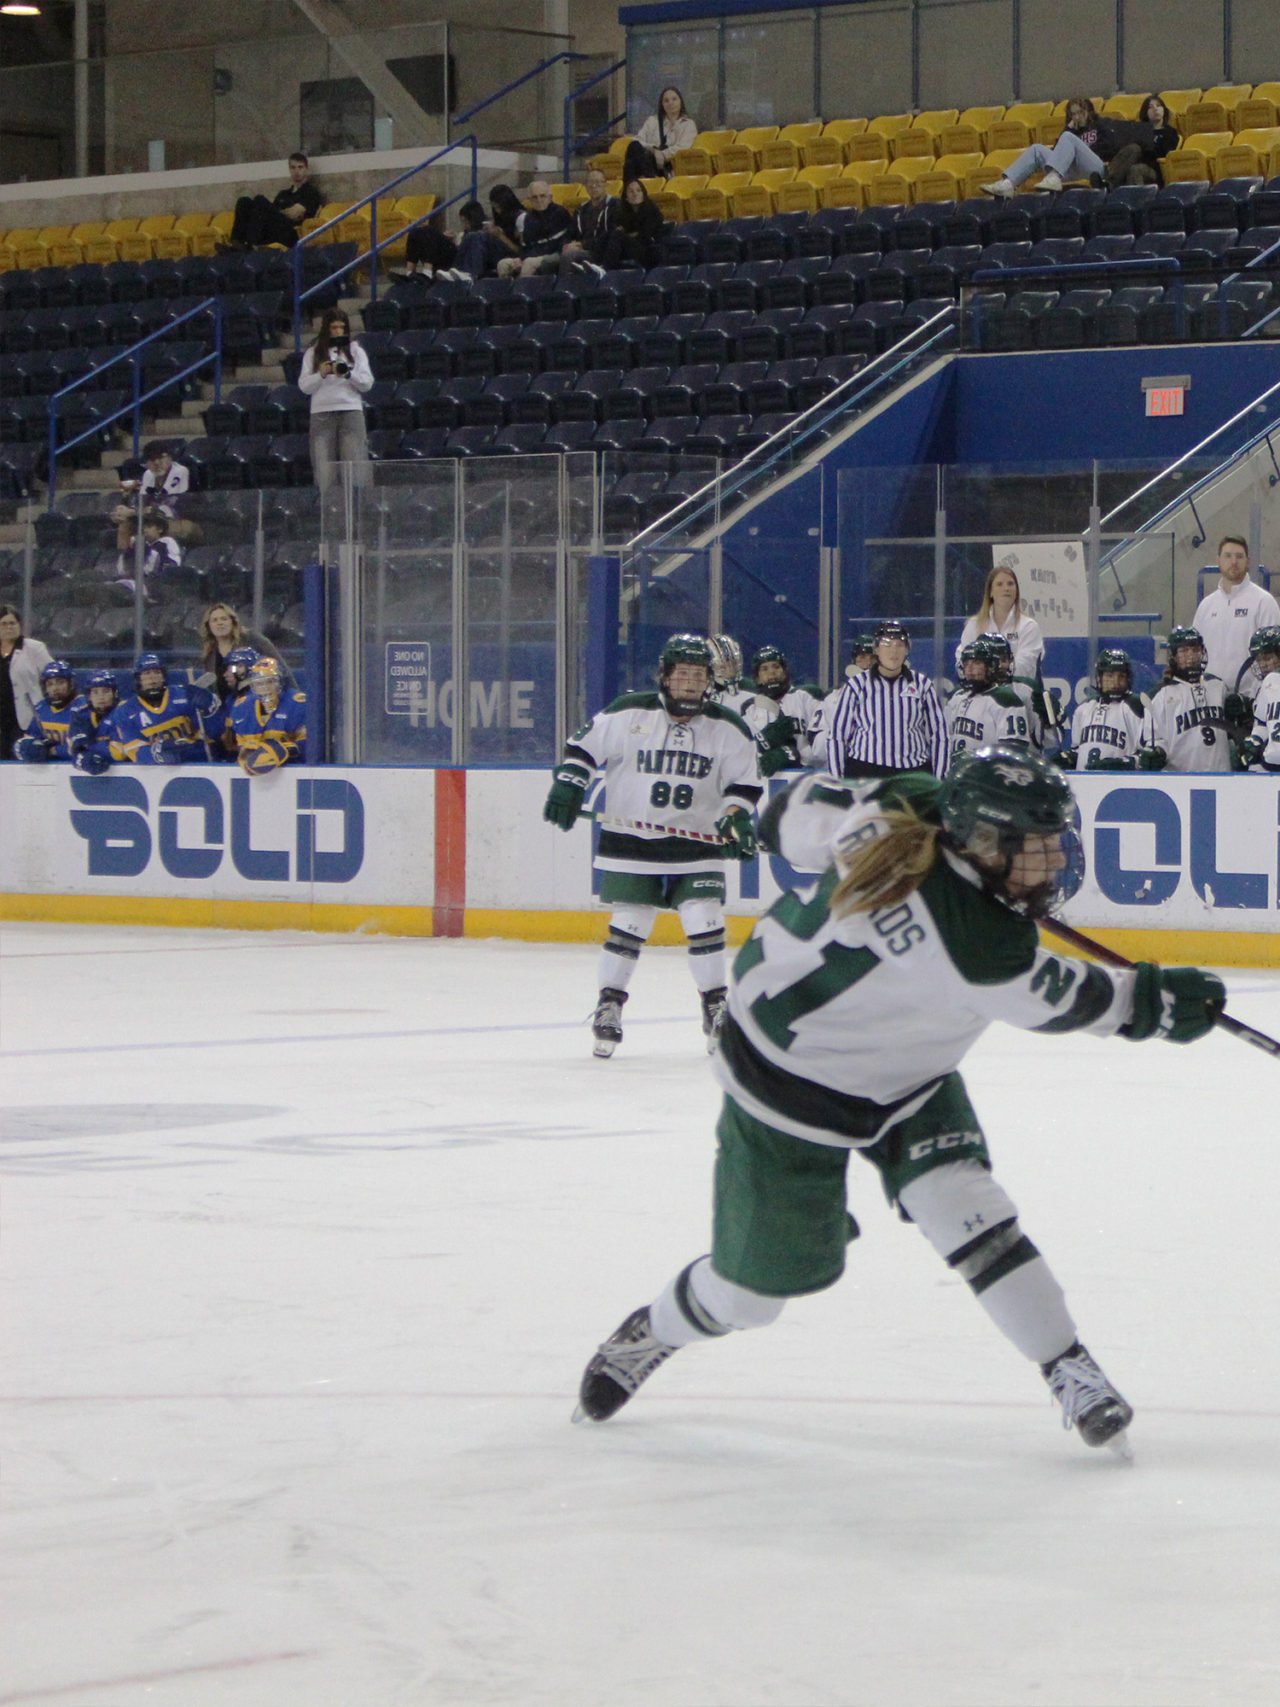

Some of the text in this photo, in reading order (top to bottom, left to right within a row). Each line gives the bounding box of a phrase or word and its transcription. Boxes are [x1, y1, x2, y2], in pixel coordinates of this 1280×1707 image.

[1151, 389, 1181, 415] EXIT
[410, 680, 535, 728] HOME
[1201, 726, 1216, 746] 9
[557, 772, 590, 789] CC
[651, 781, 694, 810] 88
[69, 776, 365, 883] BOLD
[909, 1131, 984, 1161] CCM
